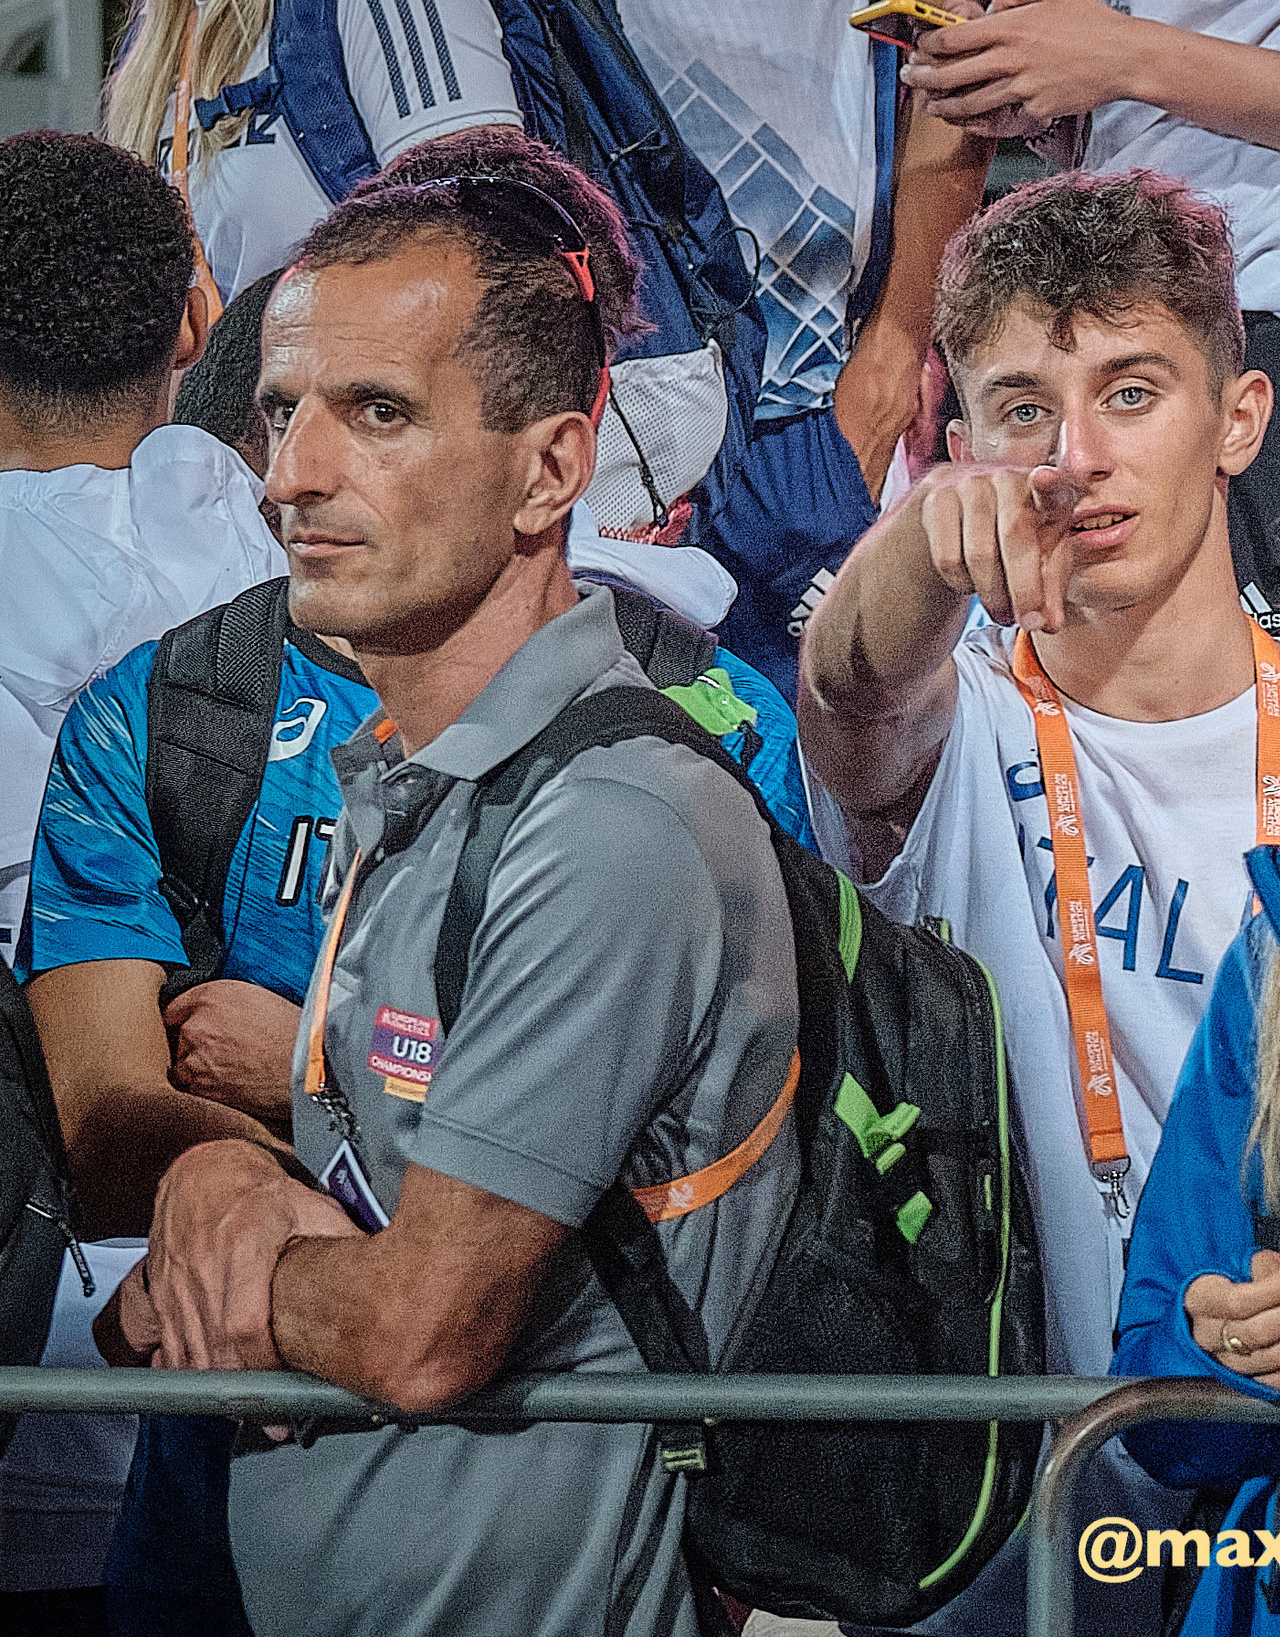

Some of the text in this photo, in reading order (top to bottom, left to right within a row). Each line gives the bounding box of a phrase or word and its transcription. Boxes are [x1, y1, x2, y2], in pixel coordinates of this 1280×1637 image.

[1054, 773, 1066, 812] EUROPEAN
[1060, 773, 1072, 812] ATHLETICS
[1265, 797, 1274, 836] ATHLETICS
[1273, 798, 1280, 836] EUROPEAN
[1069, 901, 1081, 942] EUROPEAN
[1075, 900, 1088, 941] ATHLETICS
[392, 1035, 433, 1064] U18
